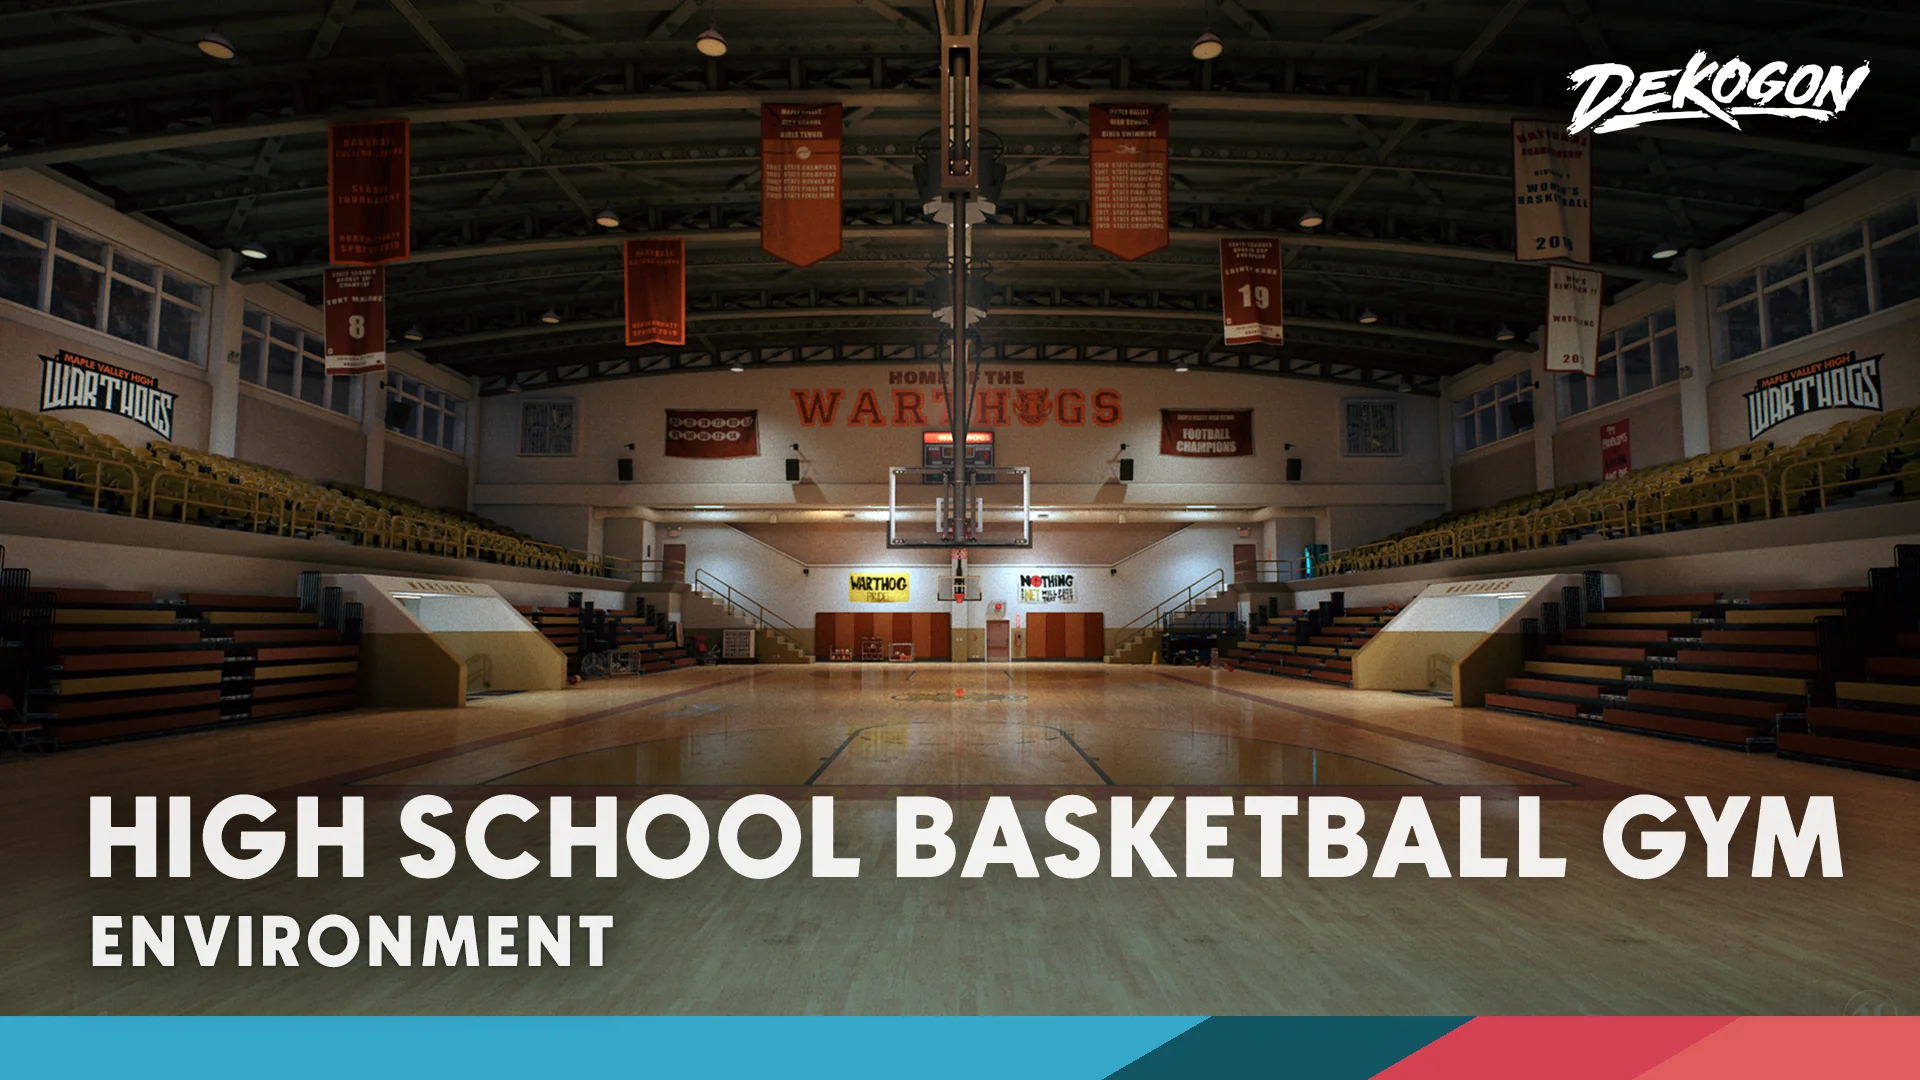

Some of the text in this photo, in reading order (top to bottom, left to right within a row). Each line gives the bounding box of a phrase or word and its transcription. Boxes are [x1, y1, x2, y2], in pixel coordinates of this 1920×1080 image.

[1238, 284, 1269, 309] 19
[349, 315, 365, 339] 8
[1552, 315, 1594, 328] WRESING
[63, 353, 154, 386] MAPLE VALLEY HIGH
[889, 371, 950, 385] HOME
[985, 371, 1024, 385] THE
[1761, 354, 1851, 388] MAPLE VALLEY HIGH
[43, 360, 173, 440] WARTHOGS
[790, 388, 1123, 428] WARTHOGS
[1748, 359, 1880, 440] WARTHOGS
[938, 433, 991, 442] WAHOGS
[1182, 427, 1231, 441] FOOTBALL
[1176, 440, 1237, 453] CHAMPIONS
[850, 576, 908, 591] WARTHOG
[1020, 574, 1074, 588] NOTHING
